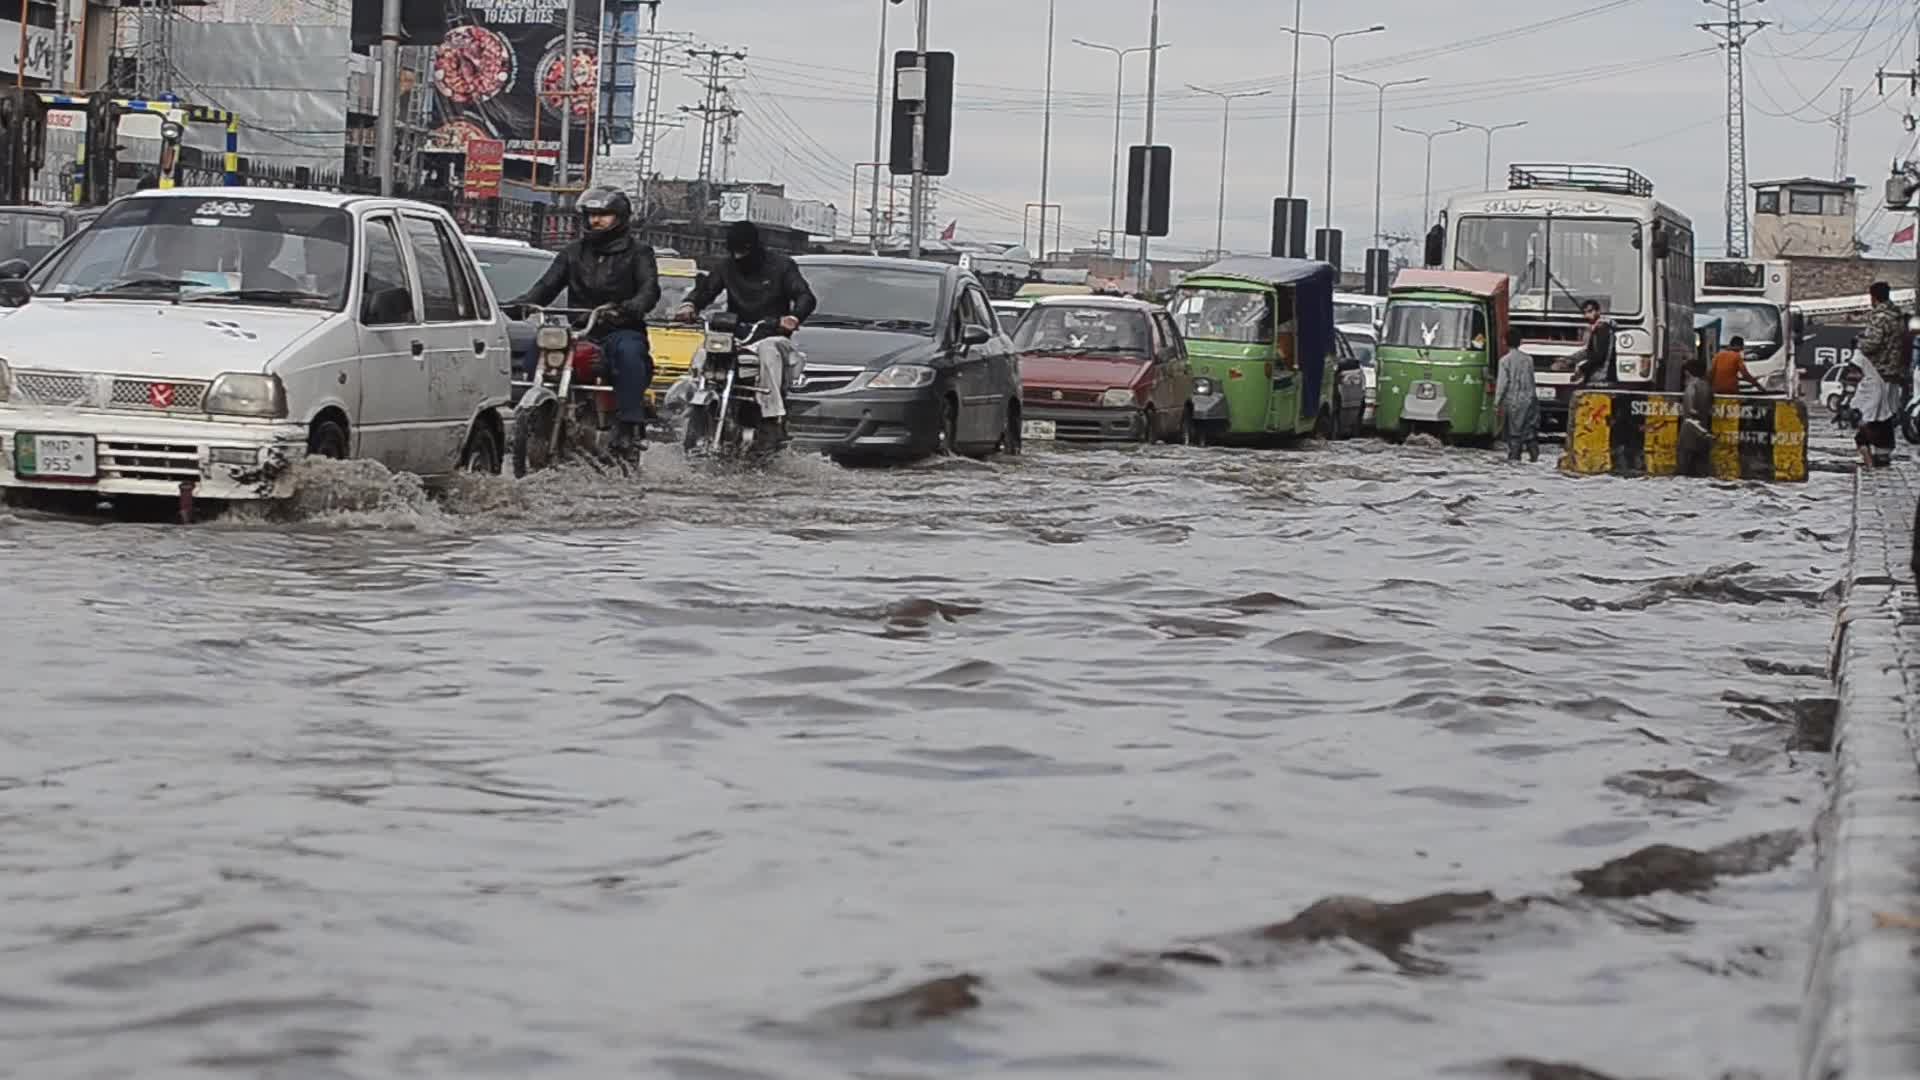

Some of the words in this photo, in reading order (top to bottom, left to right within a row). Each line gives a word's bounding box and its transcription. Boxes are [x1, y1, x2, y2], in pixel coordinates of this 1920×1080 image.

[484, 8, 498, 24] TO
[498, 9, 523, 24] FAST
[524, 9, 554, 24] BITES
[42, 456, 72, 472] 953
